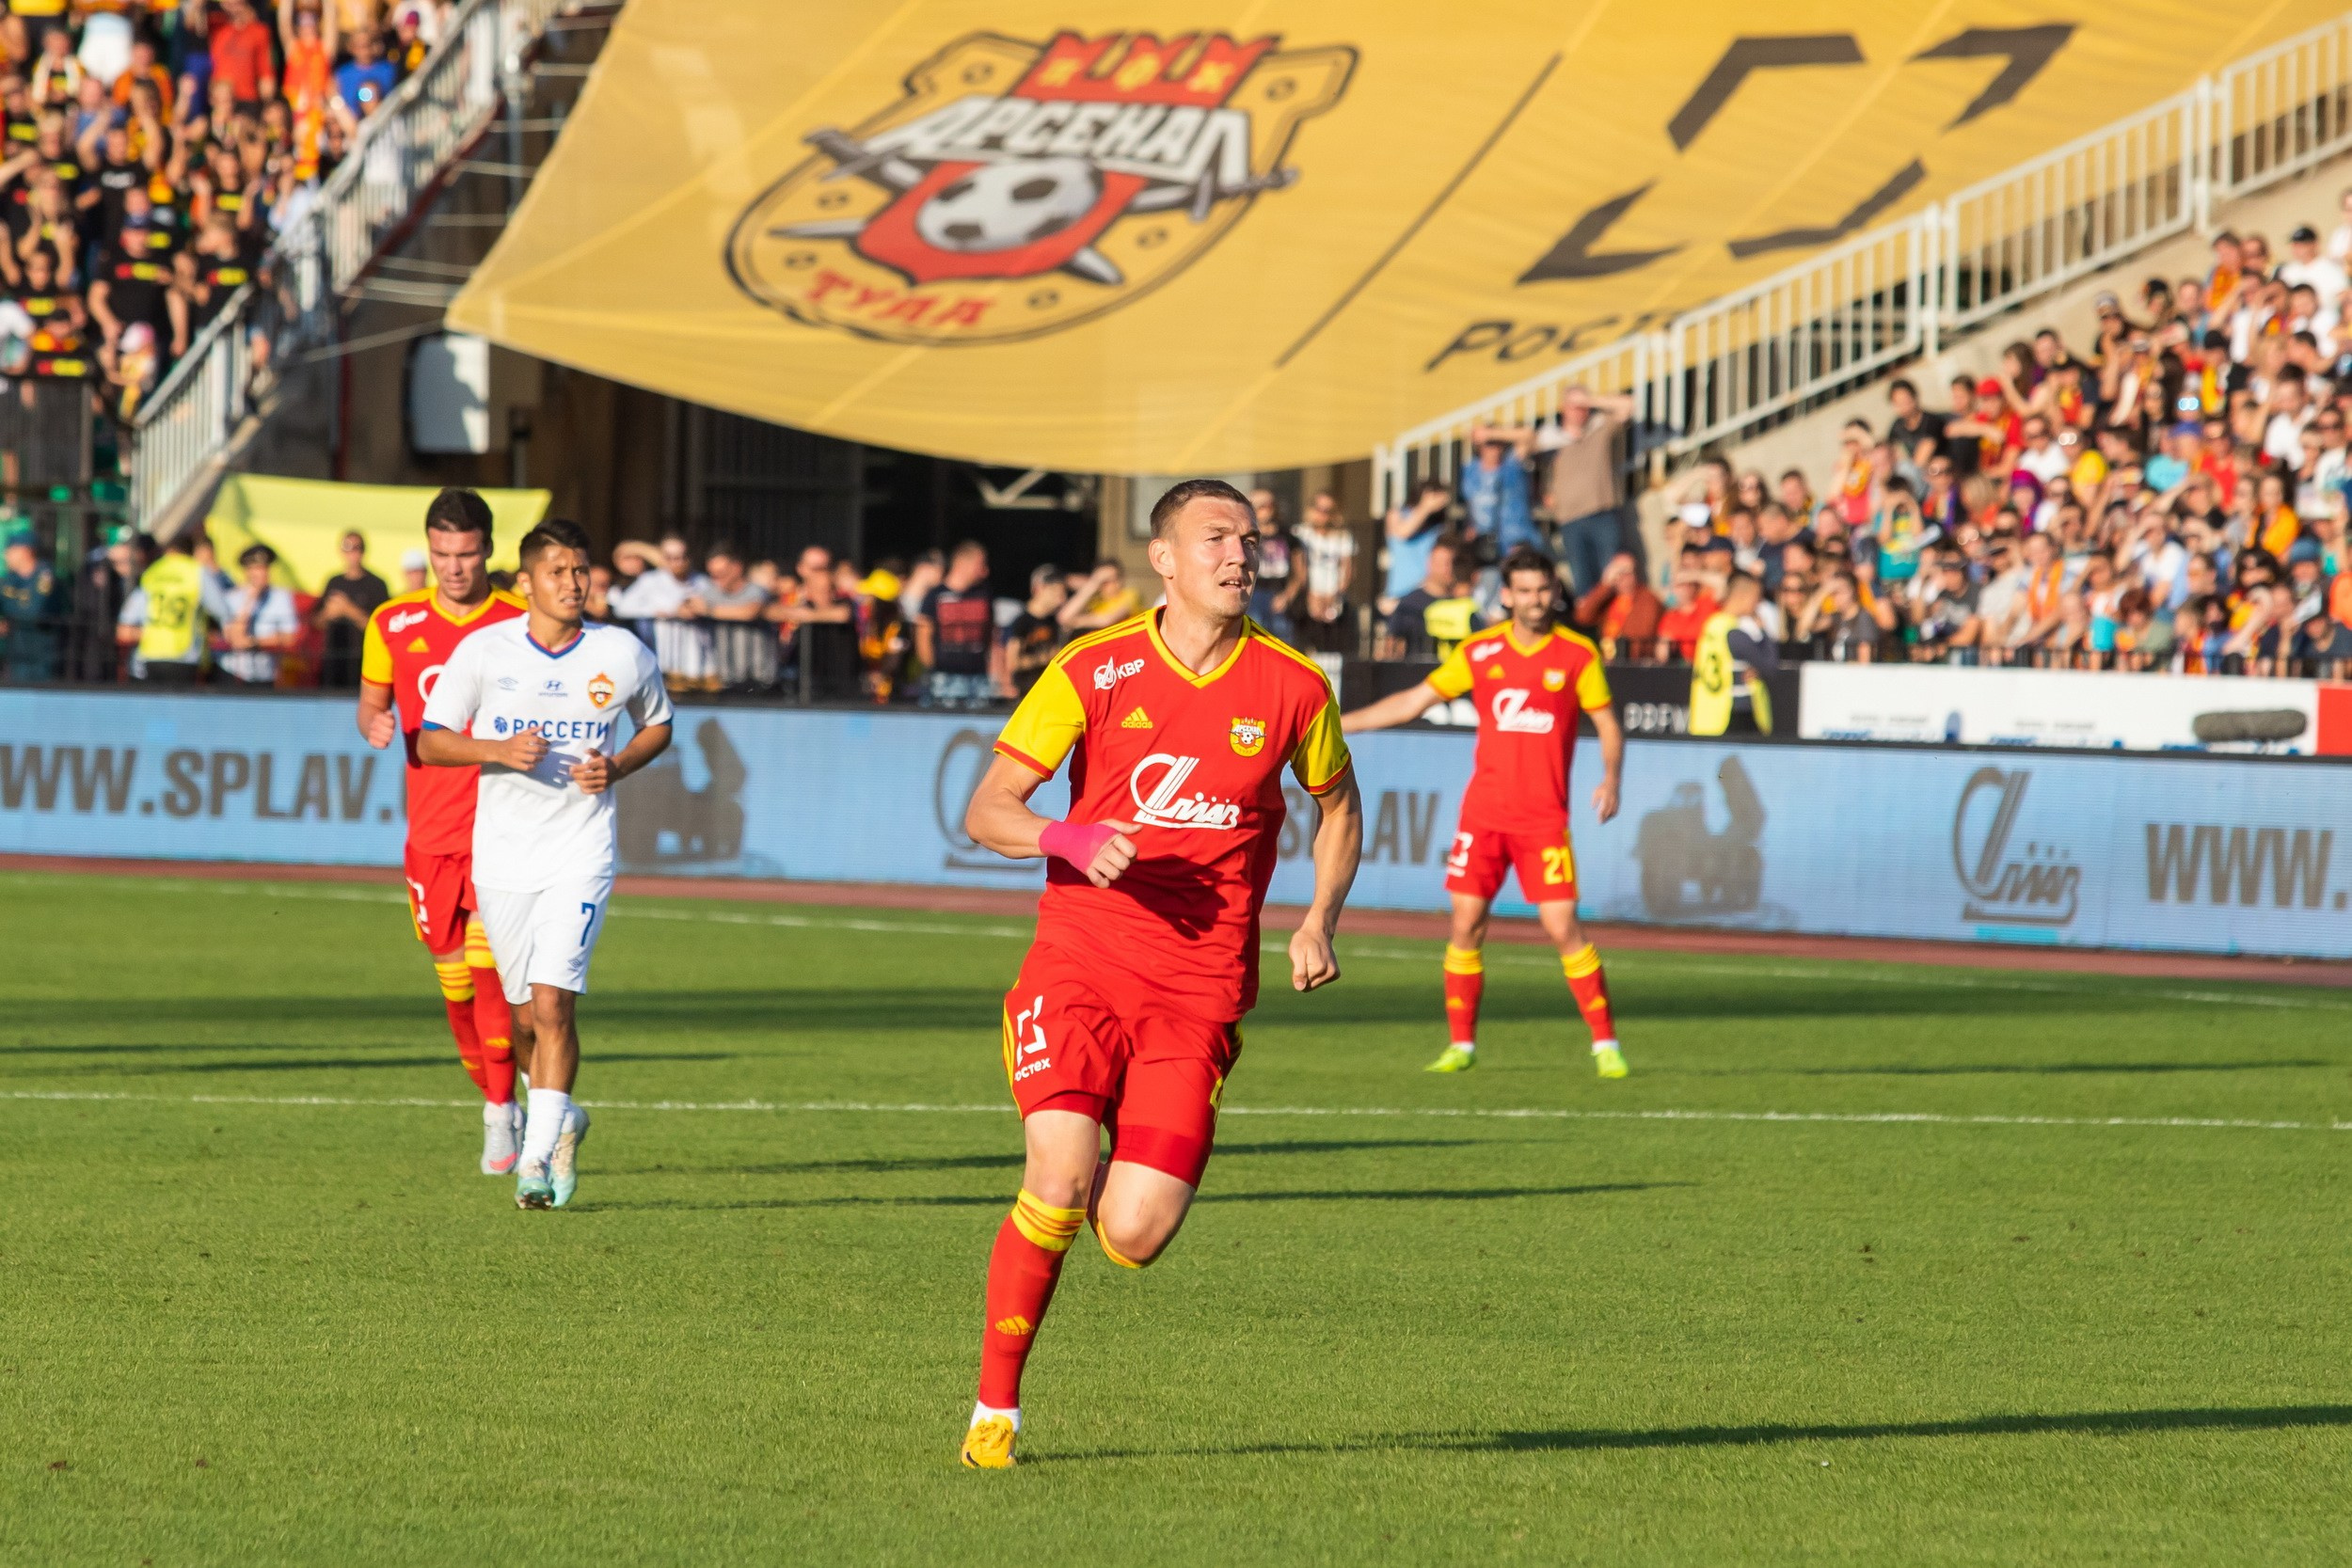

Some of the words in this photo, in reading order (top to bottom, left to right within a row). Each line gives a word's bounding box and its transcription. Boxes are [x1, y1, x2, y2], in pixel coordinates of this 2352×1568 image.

[862, 95, 1251, 189] АРСЕНАЛ
[807, 270, 998, 326] ТУЛА
[1120, 721, 1153, 730] adidas
[1540, 846, 1573, 885] 21
[580, 902, 596, 947] 7
